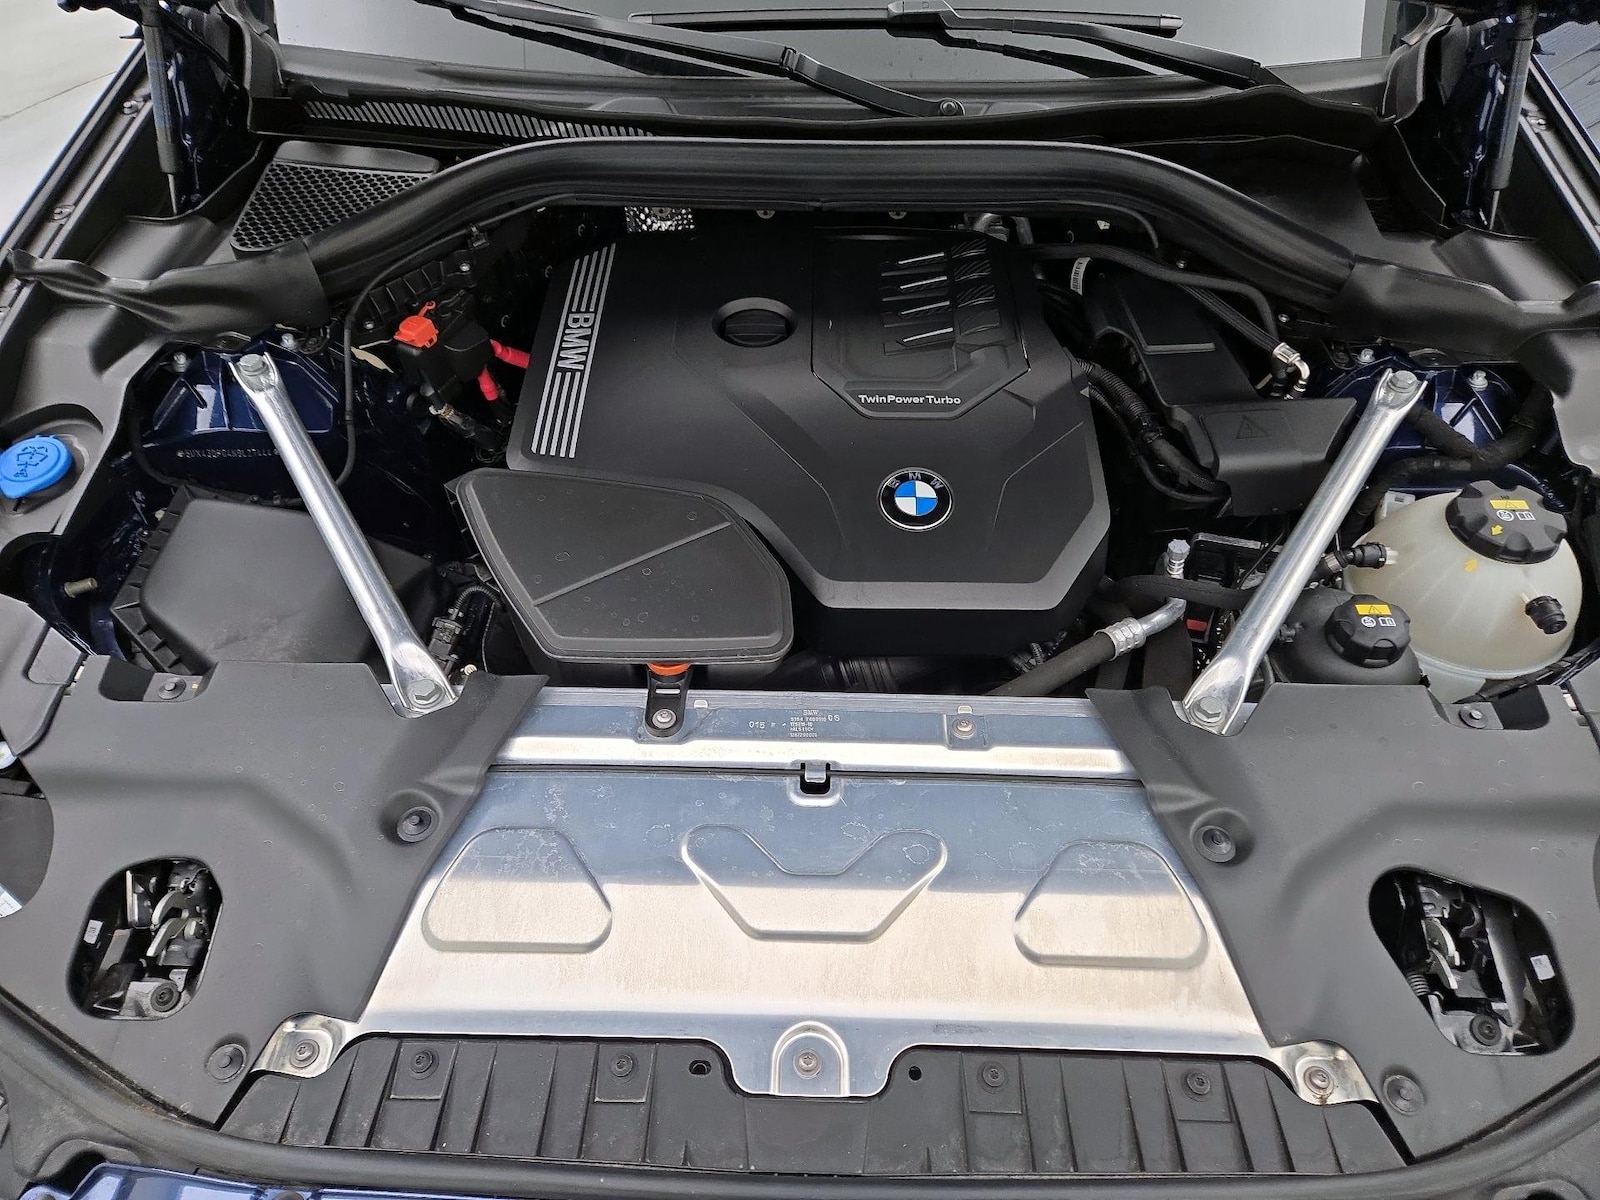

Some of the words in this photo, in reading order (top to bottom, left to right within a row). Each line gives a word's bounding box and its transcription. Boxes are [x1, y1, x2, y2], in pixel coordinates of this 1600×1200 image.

[556, 312, 596, 370] BMW
[858, 394, 924, 404] TwinPower
[925, 395, 961, 405] Turbo
[887, 471, 944, 490] BMW
